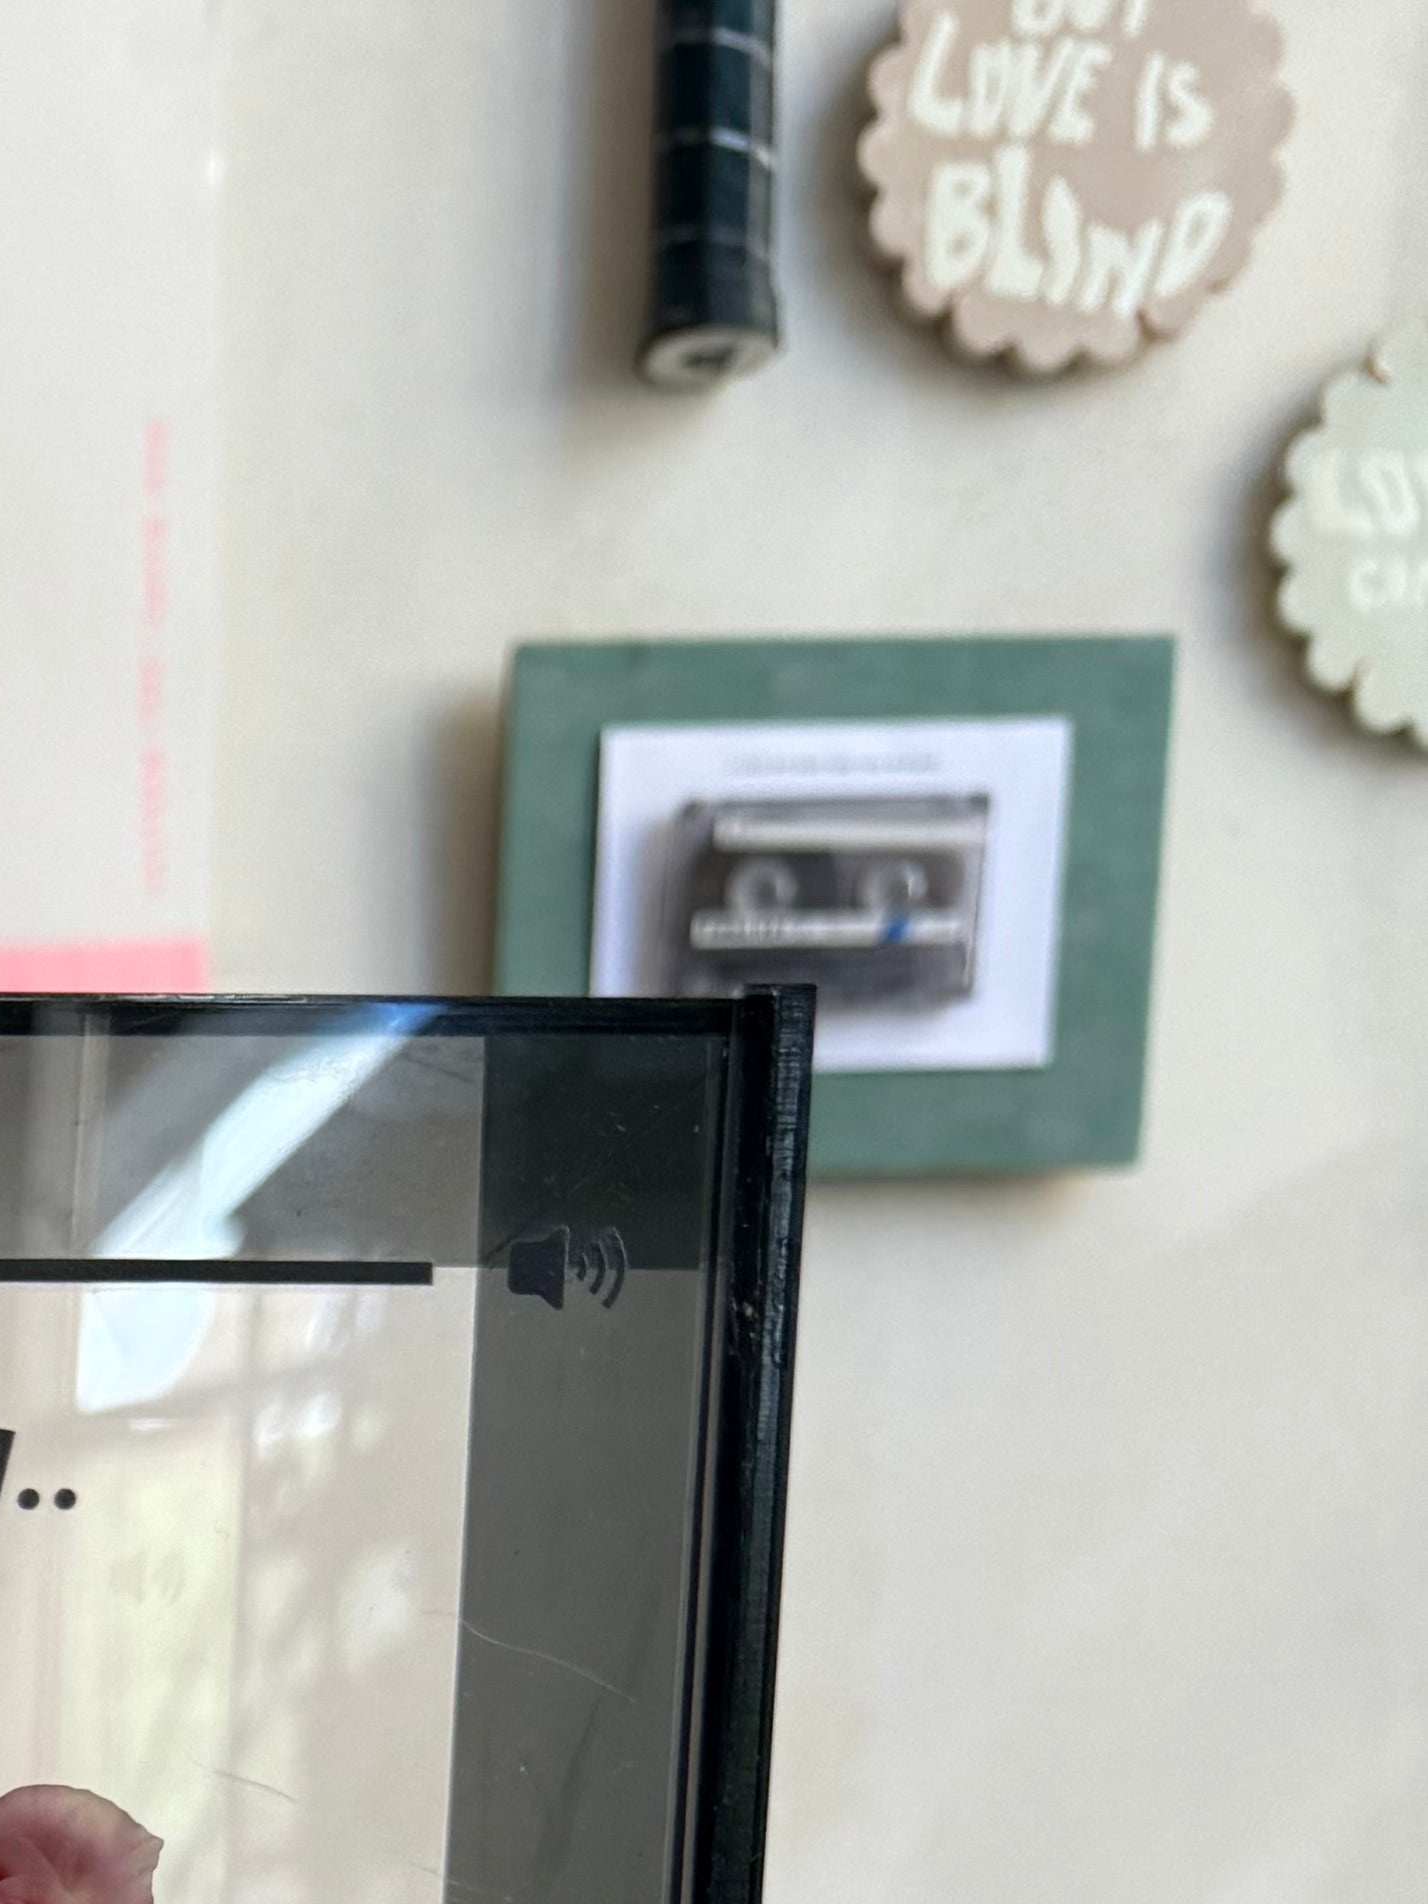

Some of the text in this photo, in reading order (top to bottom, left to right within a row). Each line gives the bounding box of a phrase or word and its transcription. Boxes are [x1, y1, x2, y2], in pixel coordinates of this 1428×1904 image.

[909, 13, 1213, 152] LOVE IS
[925, 146, 1233, 319] BLIND
